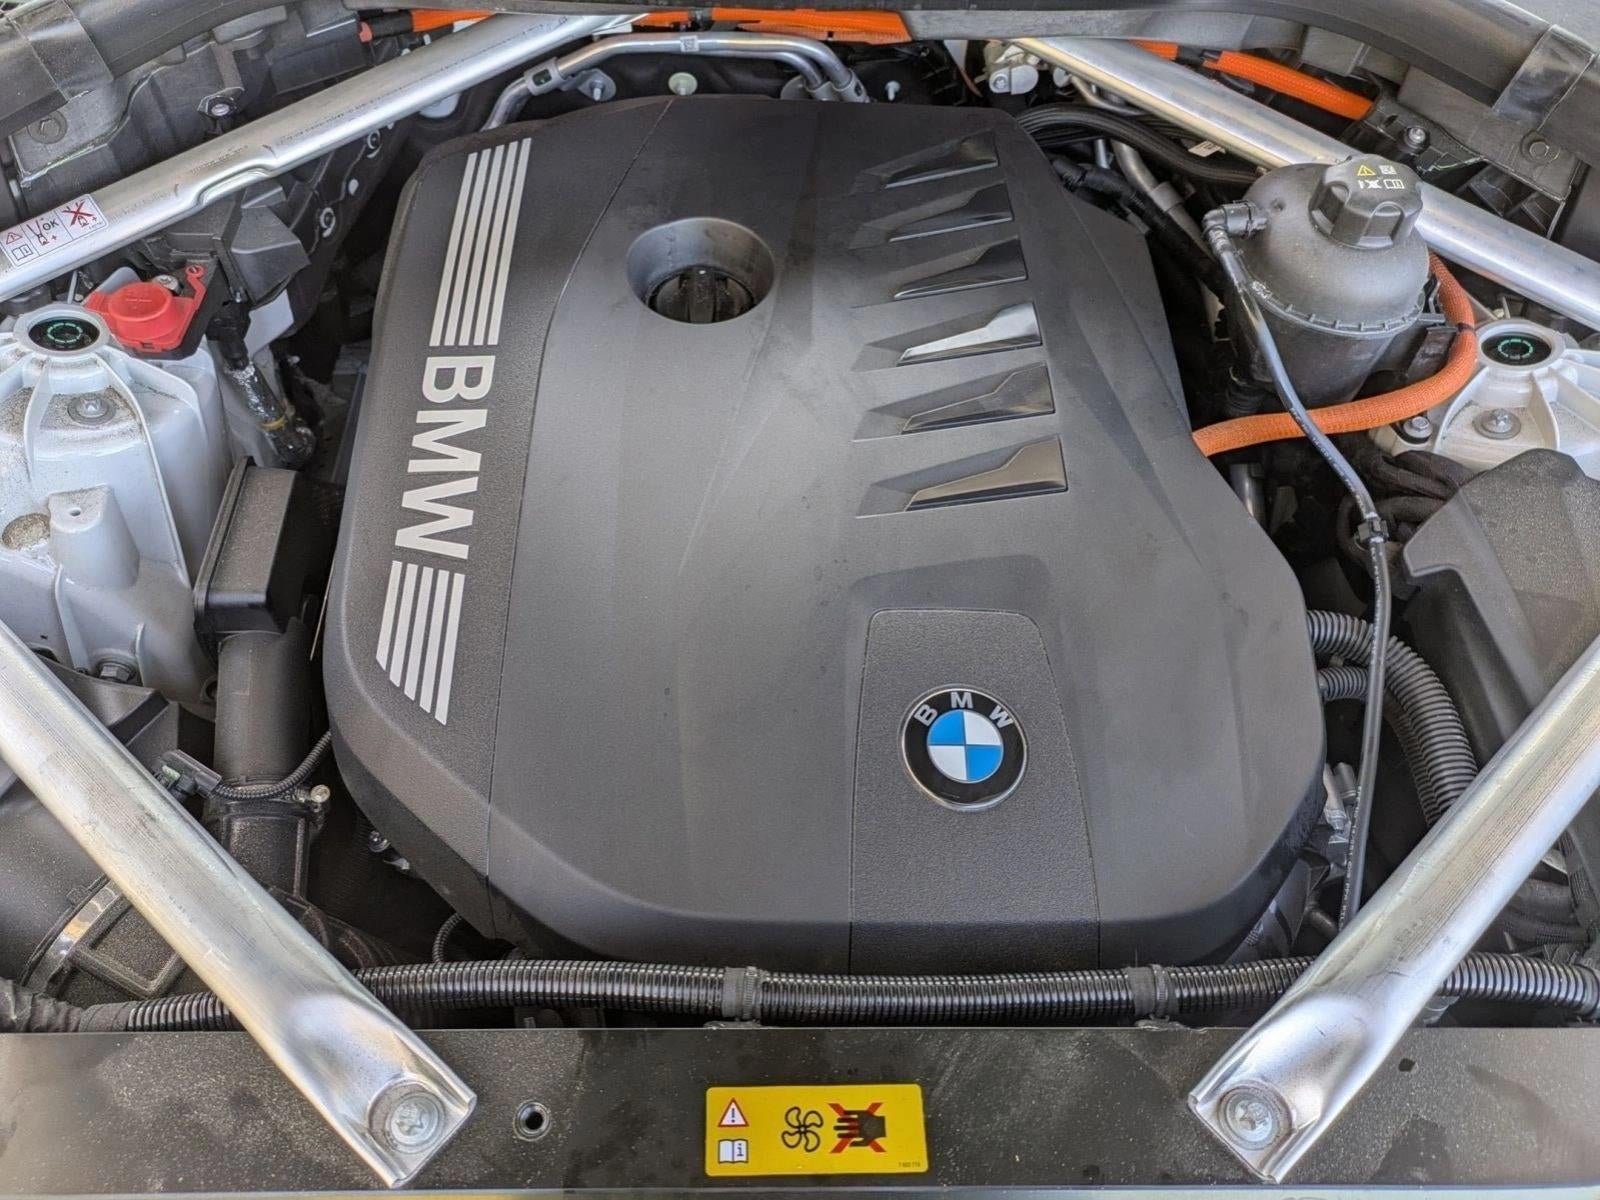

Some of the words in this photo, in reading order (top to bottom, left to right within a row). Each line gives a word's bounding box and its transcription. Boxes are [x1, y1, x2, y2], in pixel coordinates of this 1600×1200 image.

[42, 219, 59, 231] OK
[395, 355, 495, 560] BMW
[913, 691, 1014, 729] BMW
